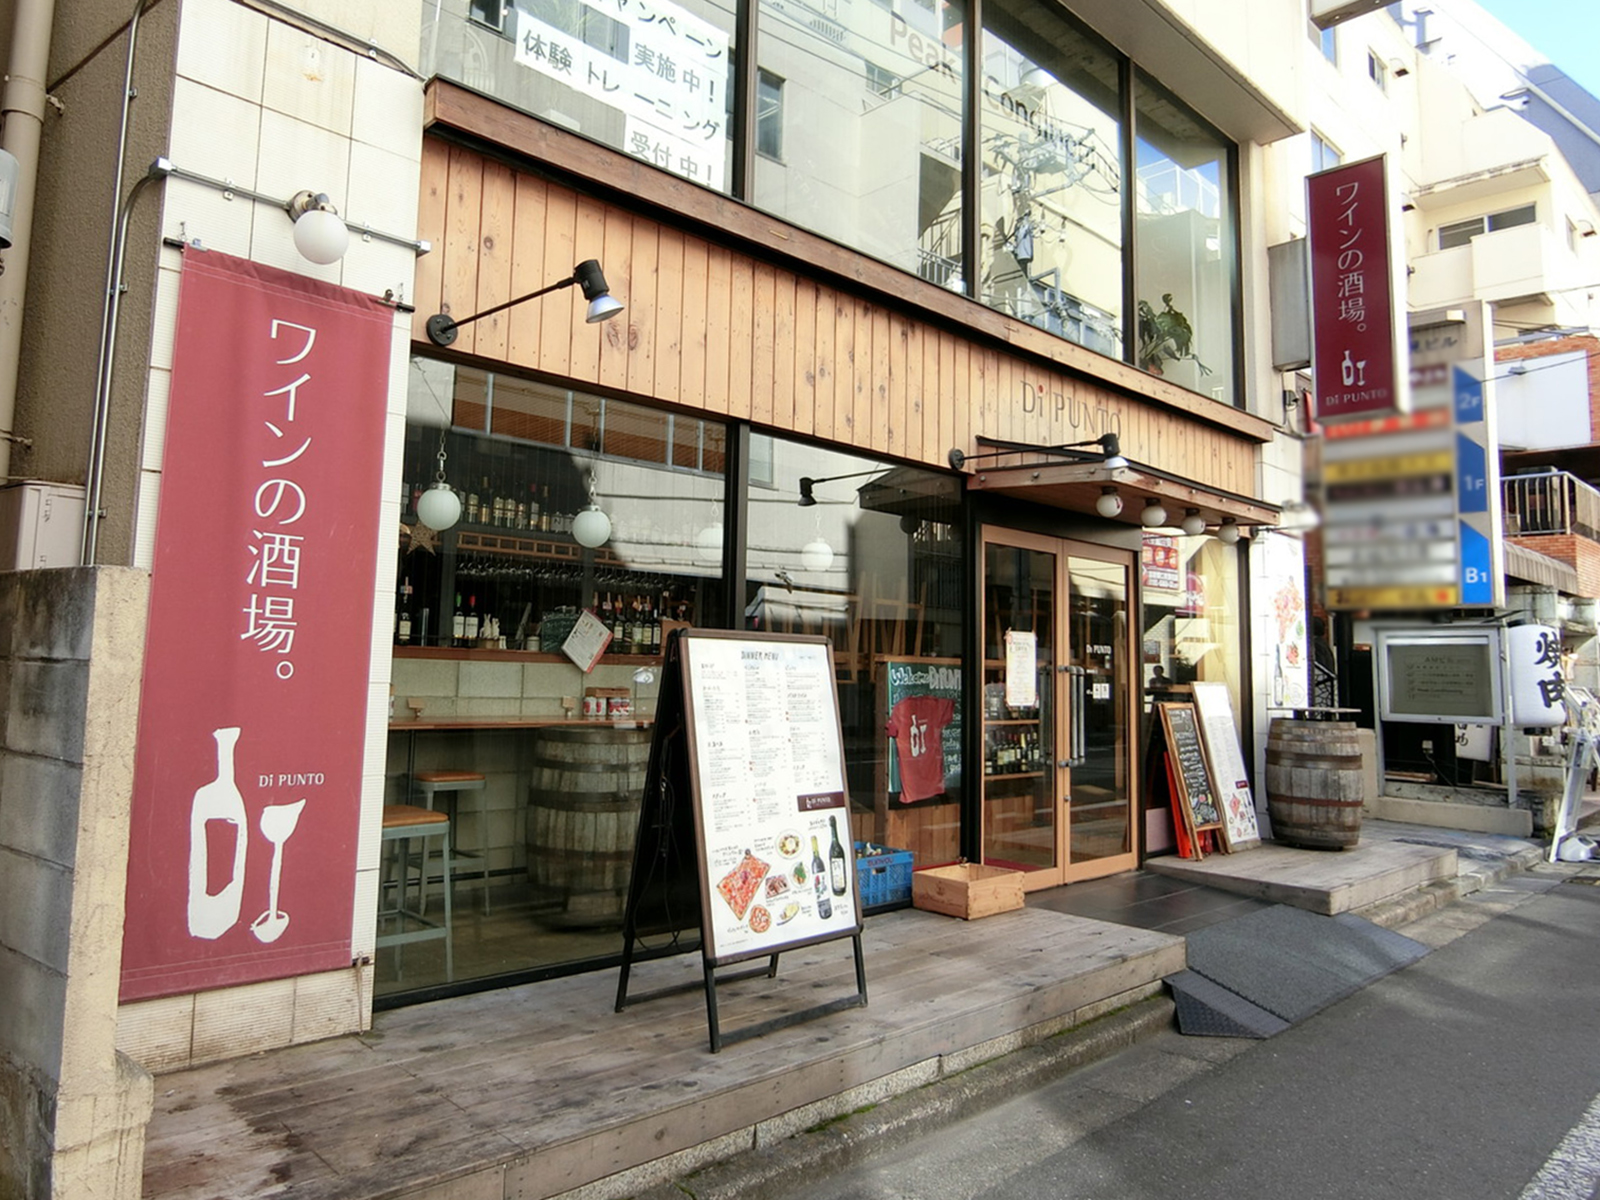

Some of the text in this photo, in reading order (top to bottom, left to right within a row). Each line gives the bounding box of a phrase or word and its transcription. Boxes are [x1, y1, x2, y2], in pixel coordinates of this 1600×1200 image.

[1336, 182, 1367, 332] ワインの酒場。
[1343, 388, 1388, 403] PUNTO
[1459, 392, 1481, 410] 2F
[1053, 391, 1121, 440] PUNTO
[1464, 475, 1485, 492] 1F
[240, 319, 317, 680] ワインの酒場。
[1465, 567, 1488, 583] B1
[1533, 631, 1566, 709] 焼肉
[258, 773, 325, 788] Di PUNTO
